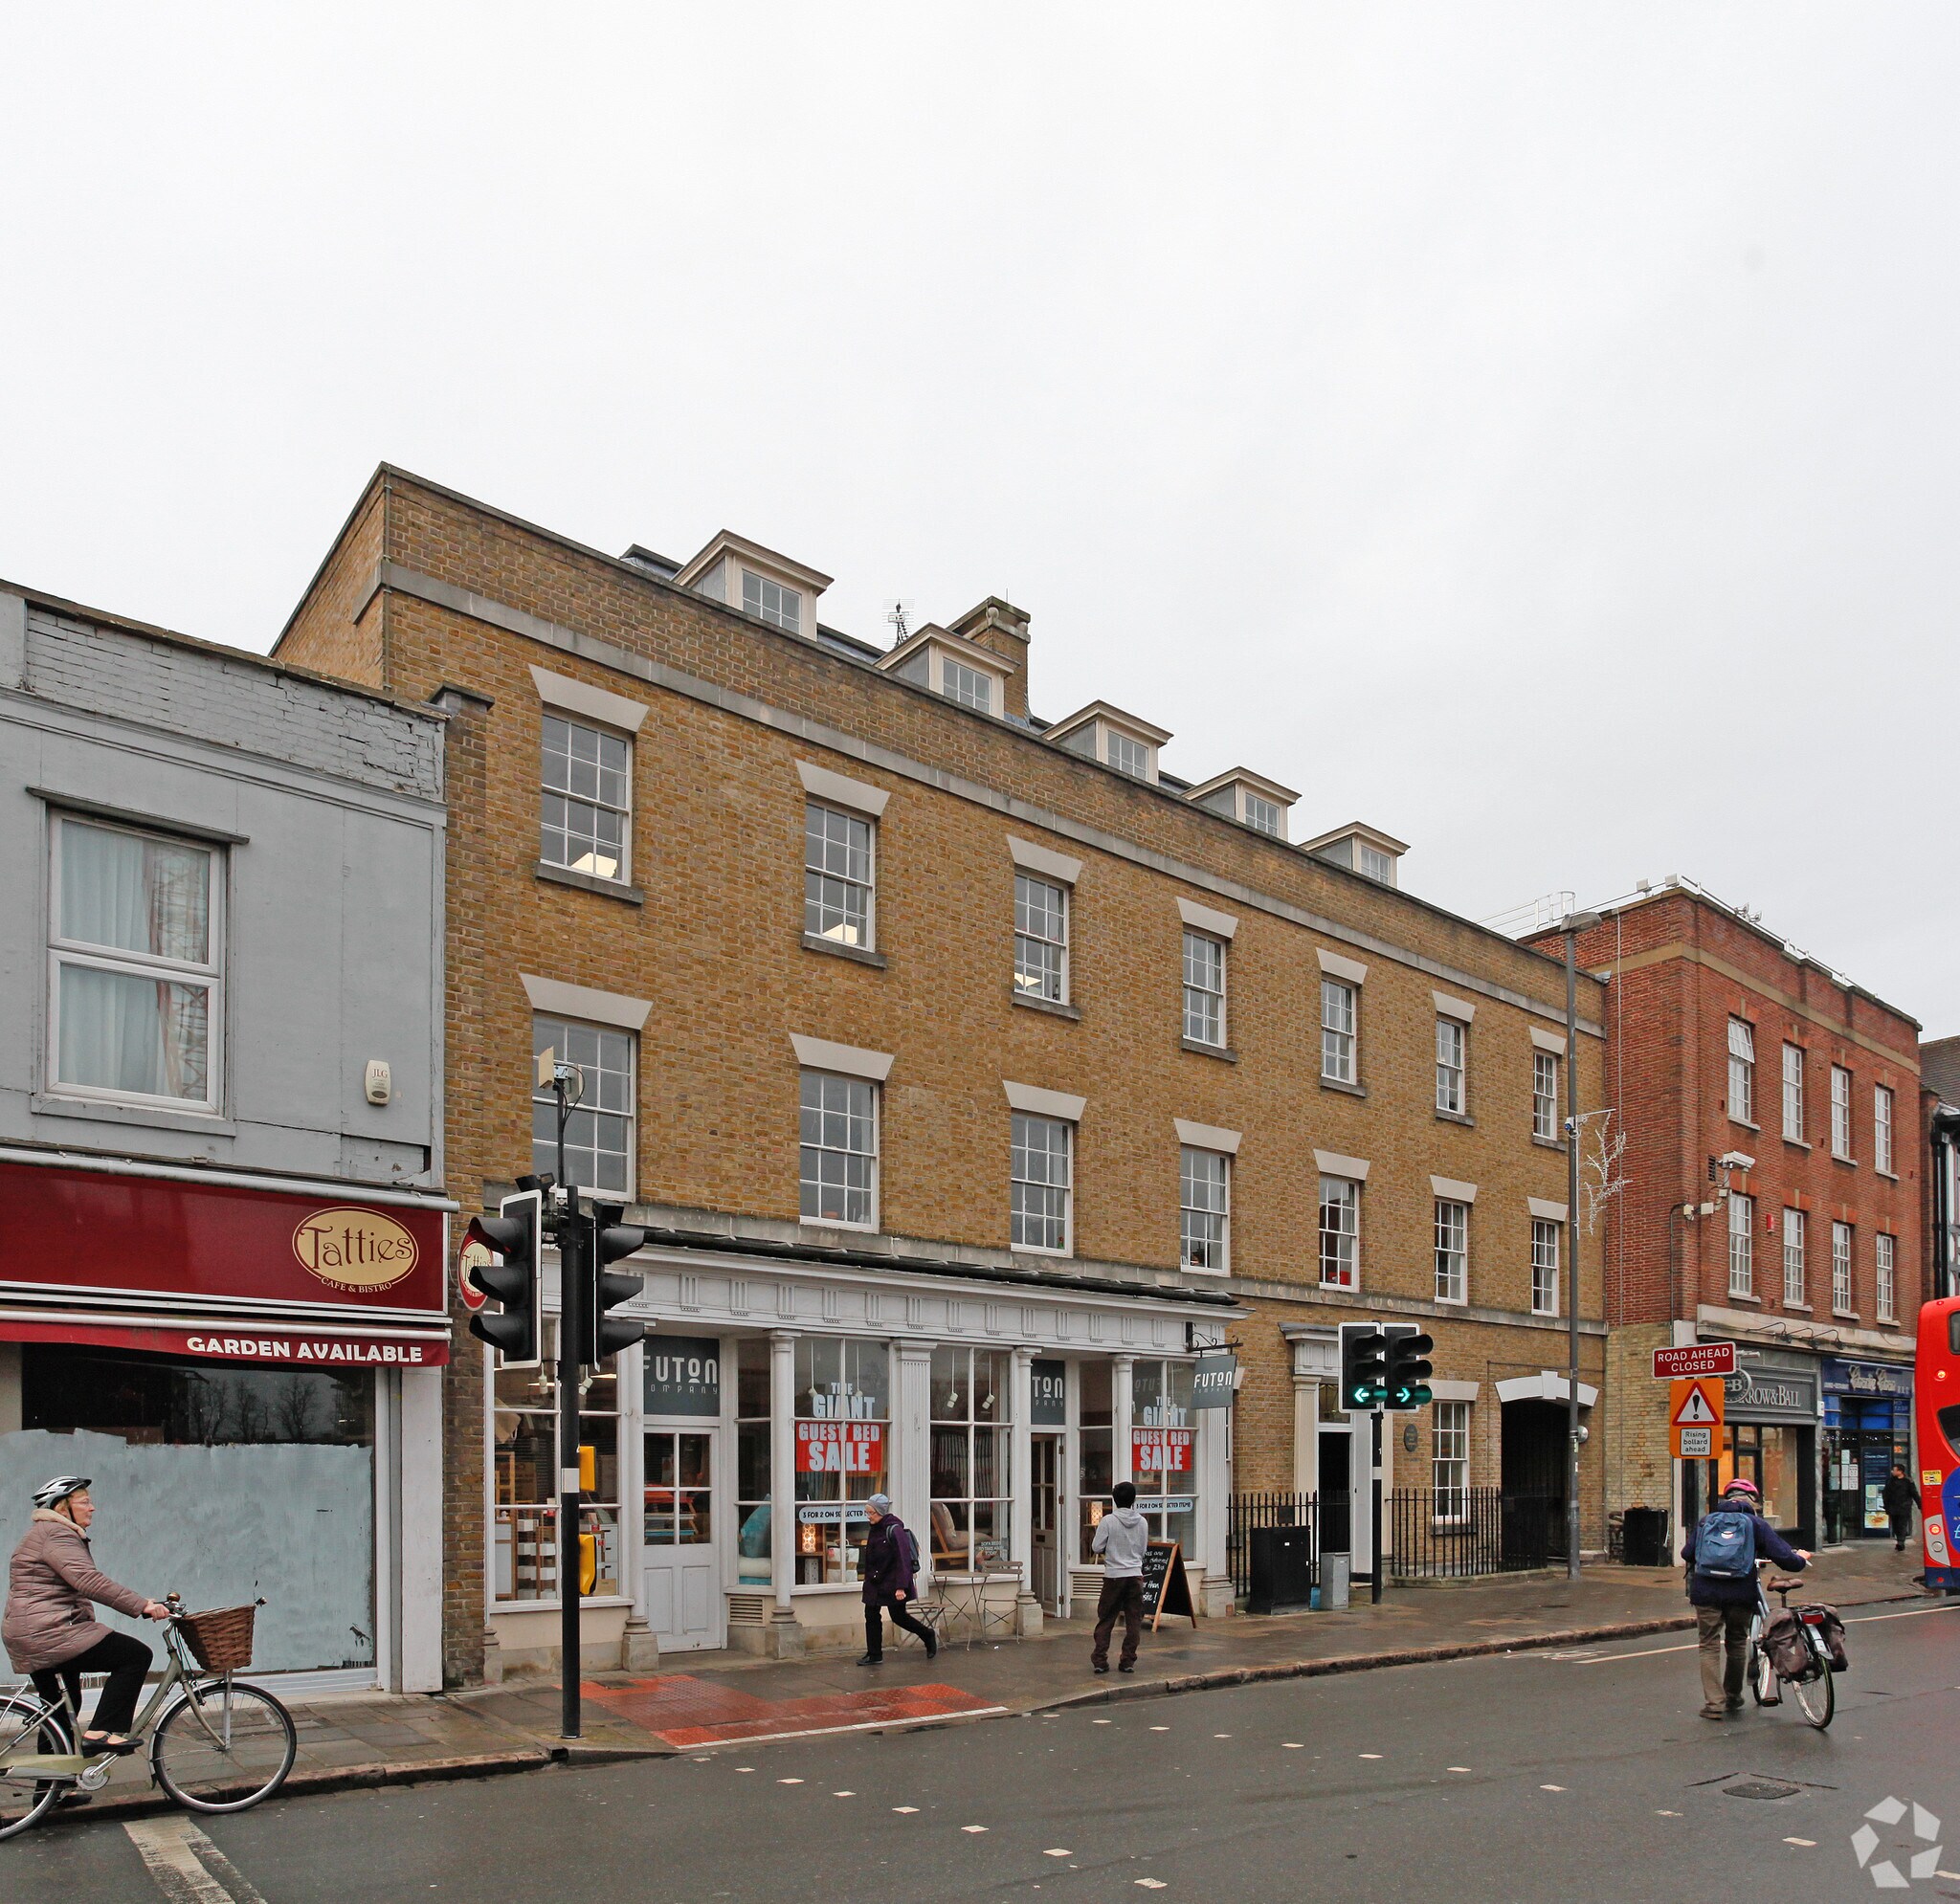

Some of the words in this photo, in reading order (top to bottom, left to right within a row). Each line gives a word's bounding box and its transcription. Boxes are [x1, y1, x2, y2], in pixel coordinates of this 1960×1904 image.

[300, 1226, 412, 1270] Tatties
[321, 1276, 346, 1292] CAFE
[347, 1284, 357, 1293] &
[358, 1282, 392, 1293] BISTRO
[187, 1337, 290, 1358] GARDEN
[297, 1342, 422, 1362] AVAILABLE
[1658, 1352, 1687, 1362] ROAD
[1690, 1348, 1729, 1360] AHEAD
[1671, 1361, 1715, 1372] CLOSED
[1032, 1376, 1063, 1398] TON
[1193, 1370, 1233, 1388] FUTON
[651, 1384, 718, 1395] OMPANY
[813, 1393, 876, 1420] GIANT
[1143, 1406, 1187, 1427] GIANT
[798, 1423, 849, 1441] GUEST
[853, 1424, 880, 1442] BED
[1170, 1430, 1190, 1446] BED
[809, 1440, 870, 1472] SALE
[1140, 1445, 1183, 1471] SALE
